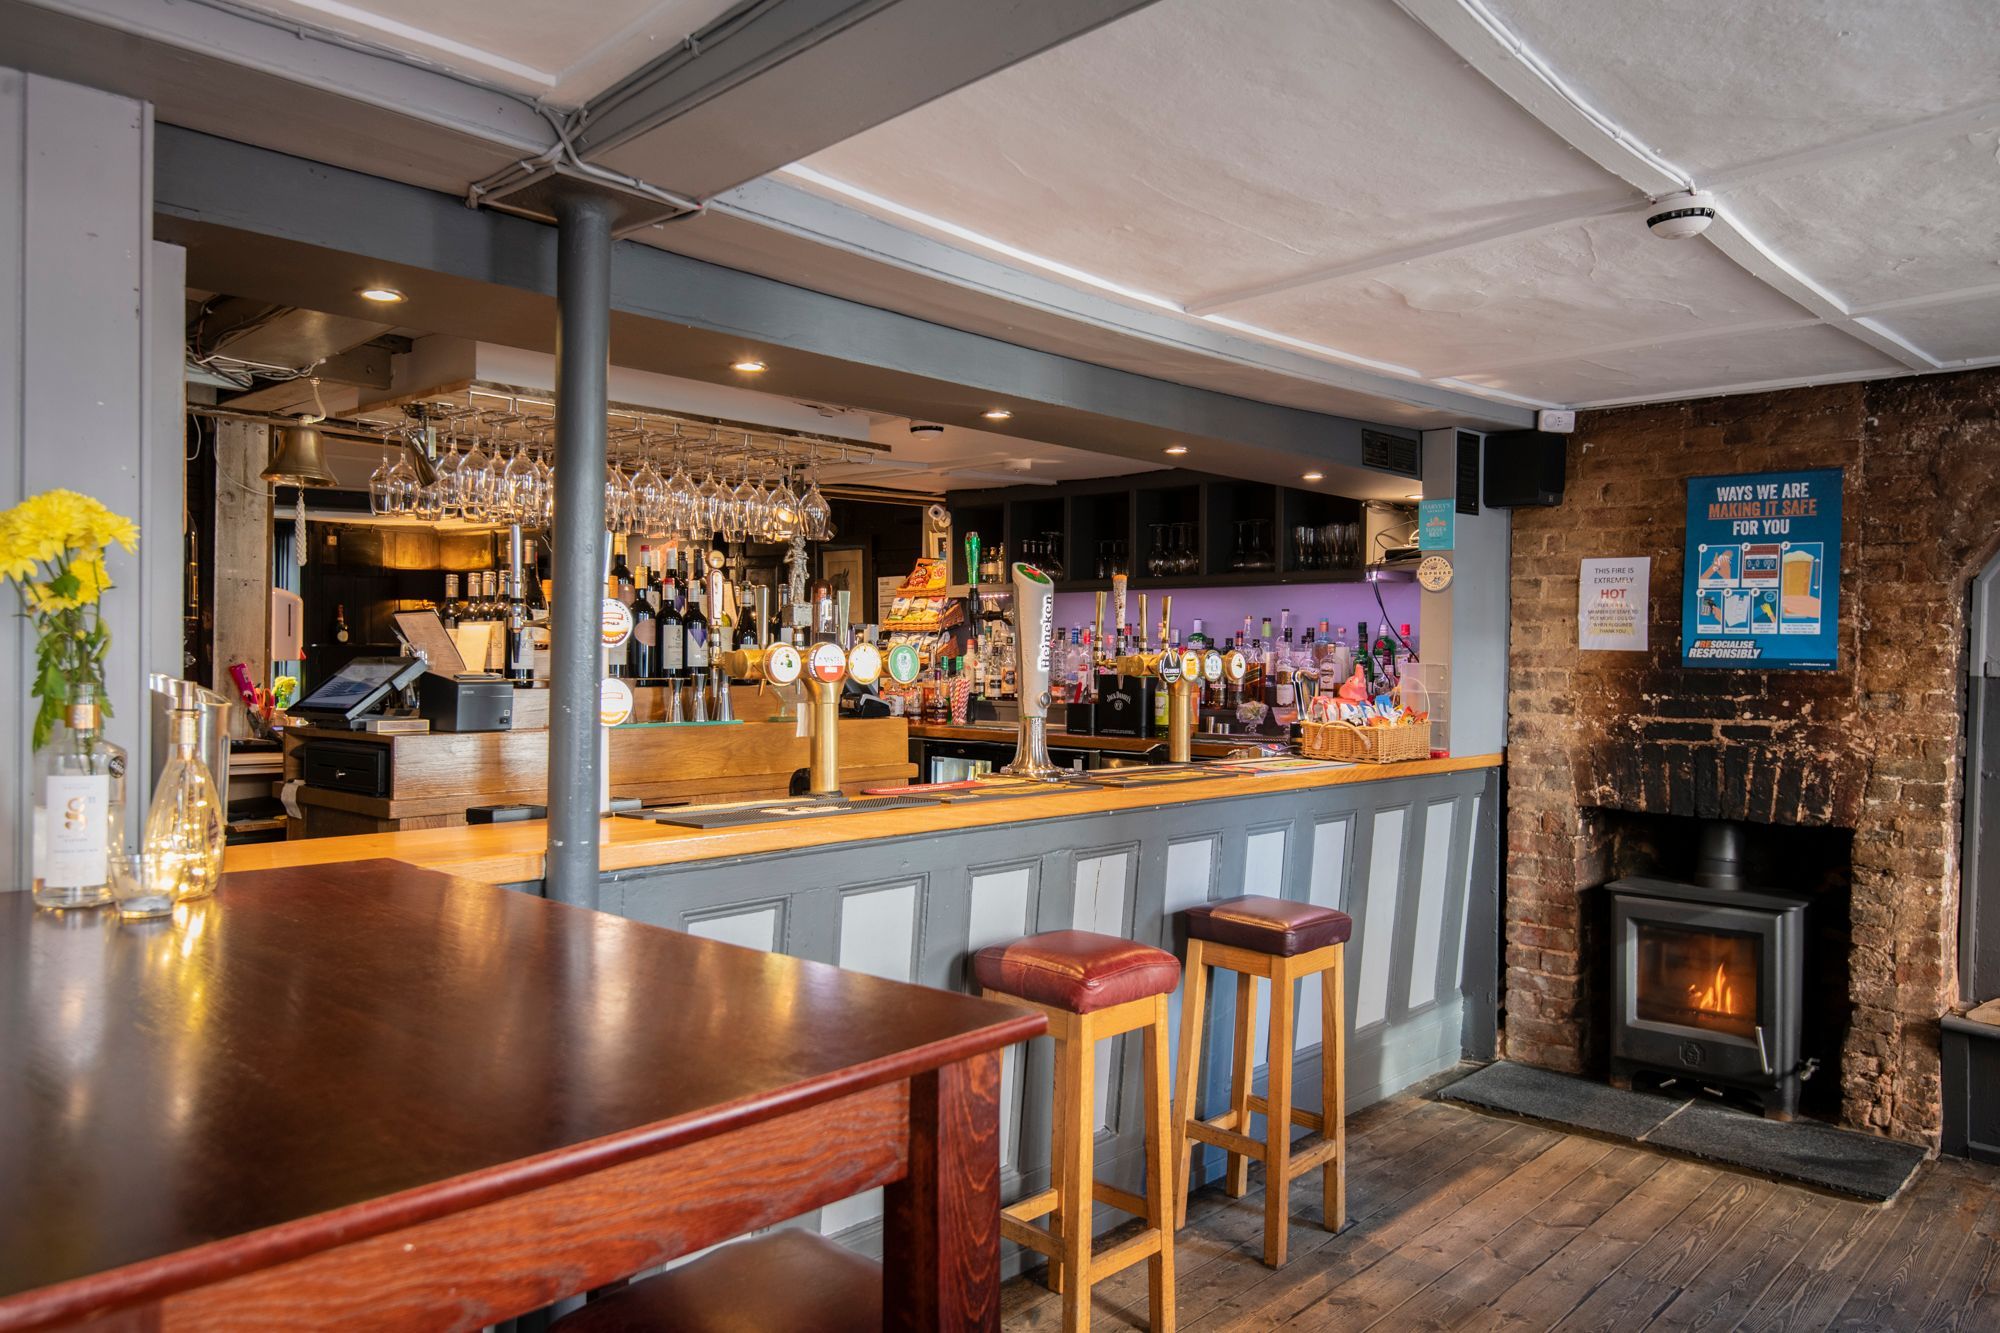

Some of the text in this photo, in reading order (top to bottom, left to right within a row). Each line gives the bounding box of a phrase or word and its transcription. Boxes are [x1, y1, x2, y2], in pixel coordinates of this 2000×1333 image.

[1716, 482, 1809, 502] WAYS WE ARE
[1708, 499, 1816, 518] MAKING IT SAFE
[1732, 519, 1790, 536] FOR YOU
[1600, 589, 1626, 599] HOT
[1040, 595, 1052, 669] Heineken
[1694, 640, 1754, 648] #RESOCIALISE
[1688, 648, 1761, 658] RESPONSIBLY
